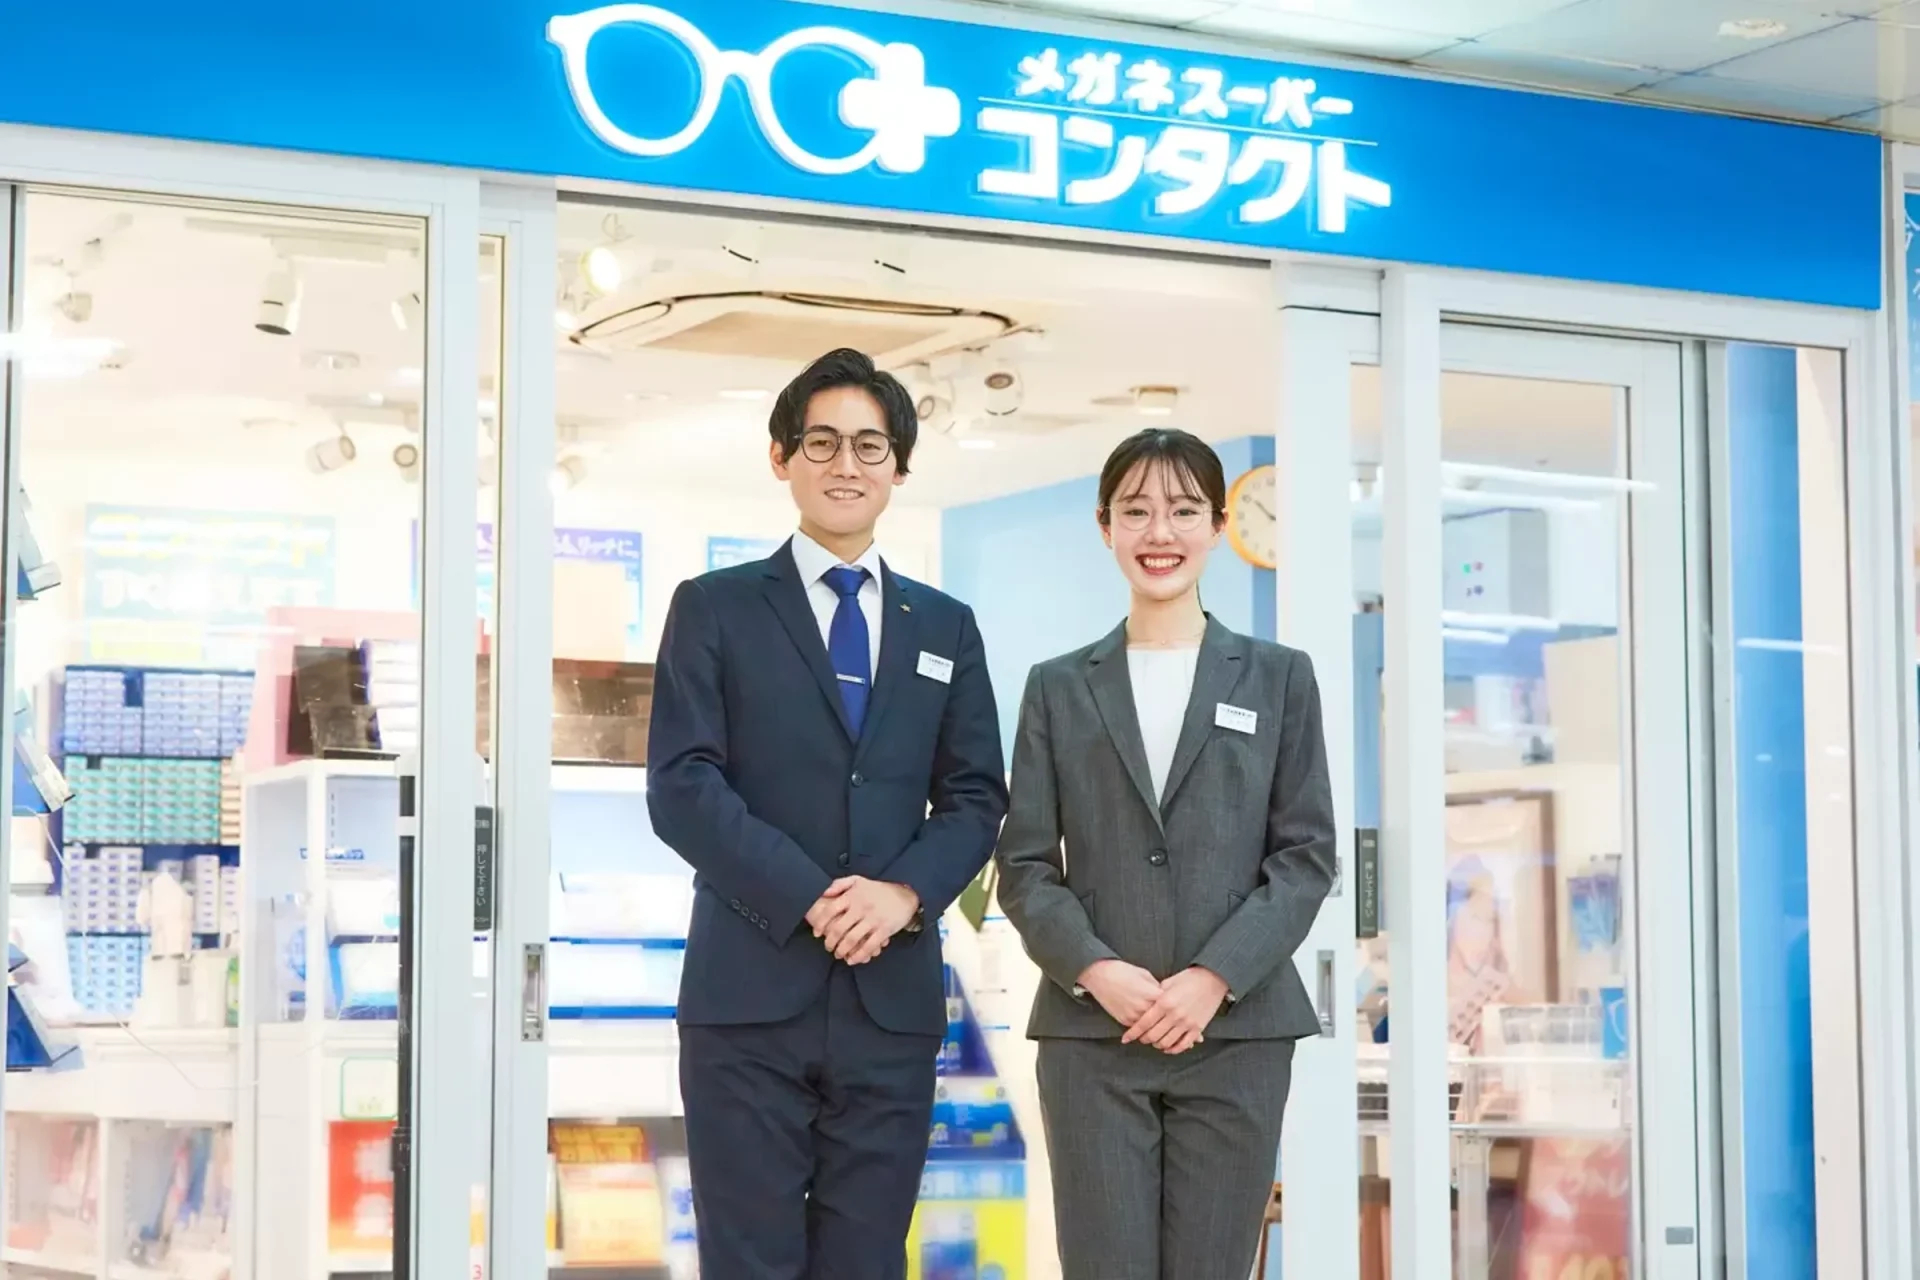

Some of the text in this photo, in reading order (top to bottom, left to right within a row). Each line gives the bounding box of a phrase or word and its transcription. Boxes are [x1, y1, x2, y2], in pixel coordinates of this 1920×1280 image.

[1015, 47, 1353, 128] メガネスーパー
[977, 107, 1391, 233] コンタクト
